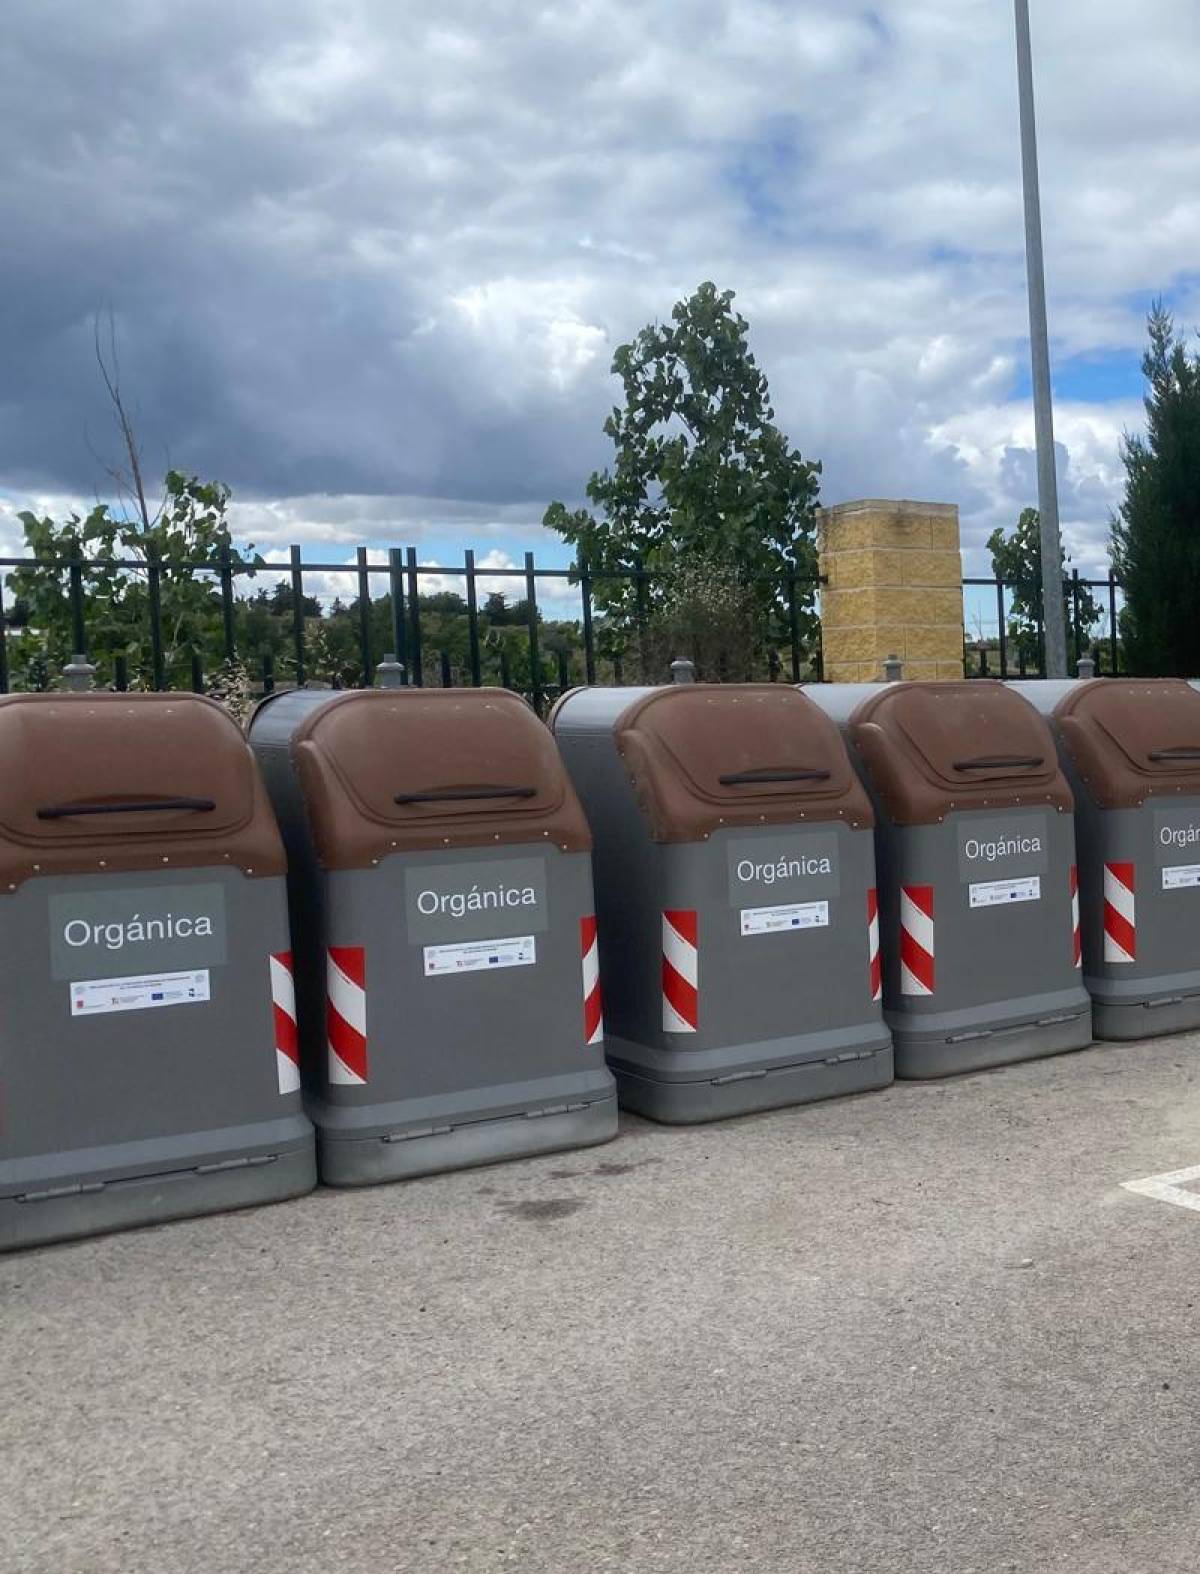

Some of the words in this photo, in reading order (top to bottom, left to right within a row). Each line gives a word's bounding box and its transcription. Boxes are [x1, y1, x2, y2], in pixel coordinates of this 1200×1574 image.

[965, 835, 1041, 861] Orgánica
[737, 855, 831, 884] Orgánica
[417, 884, 537, 917] Orgánica
[64, 913, 213, 950] Orgánica
